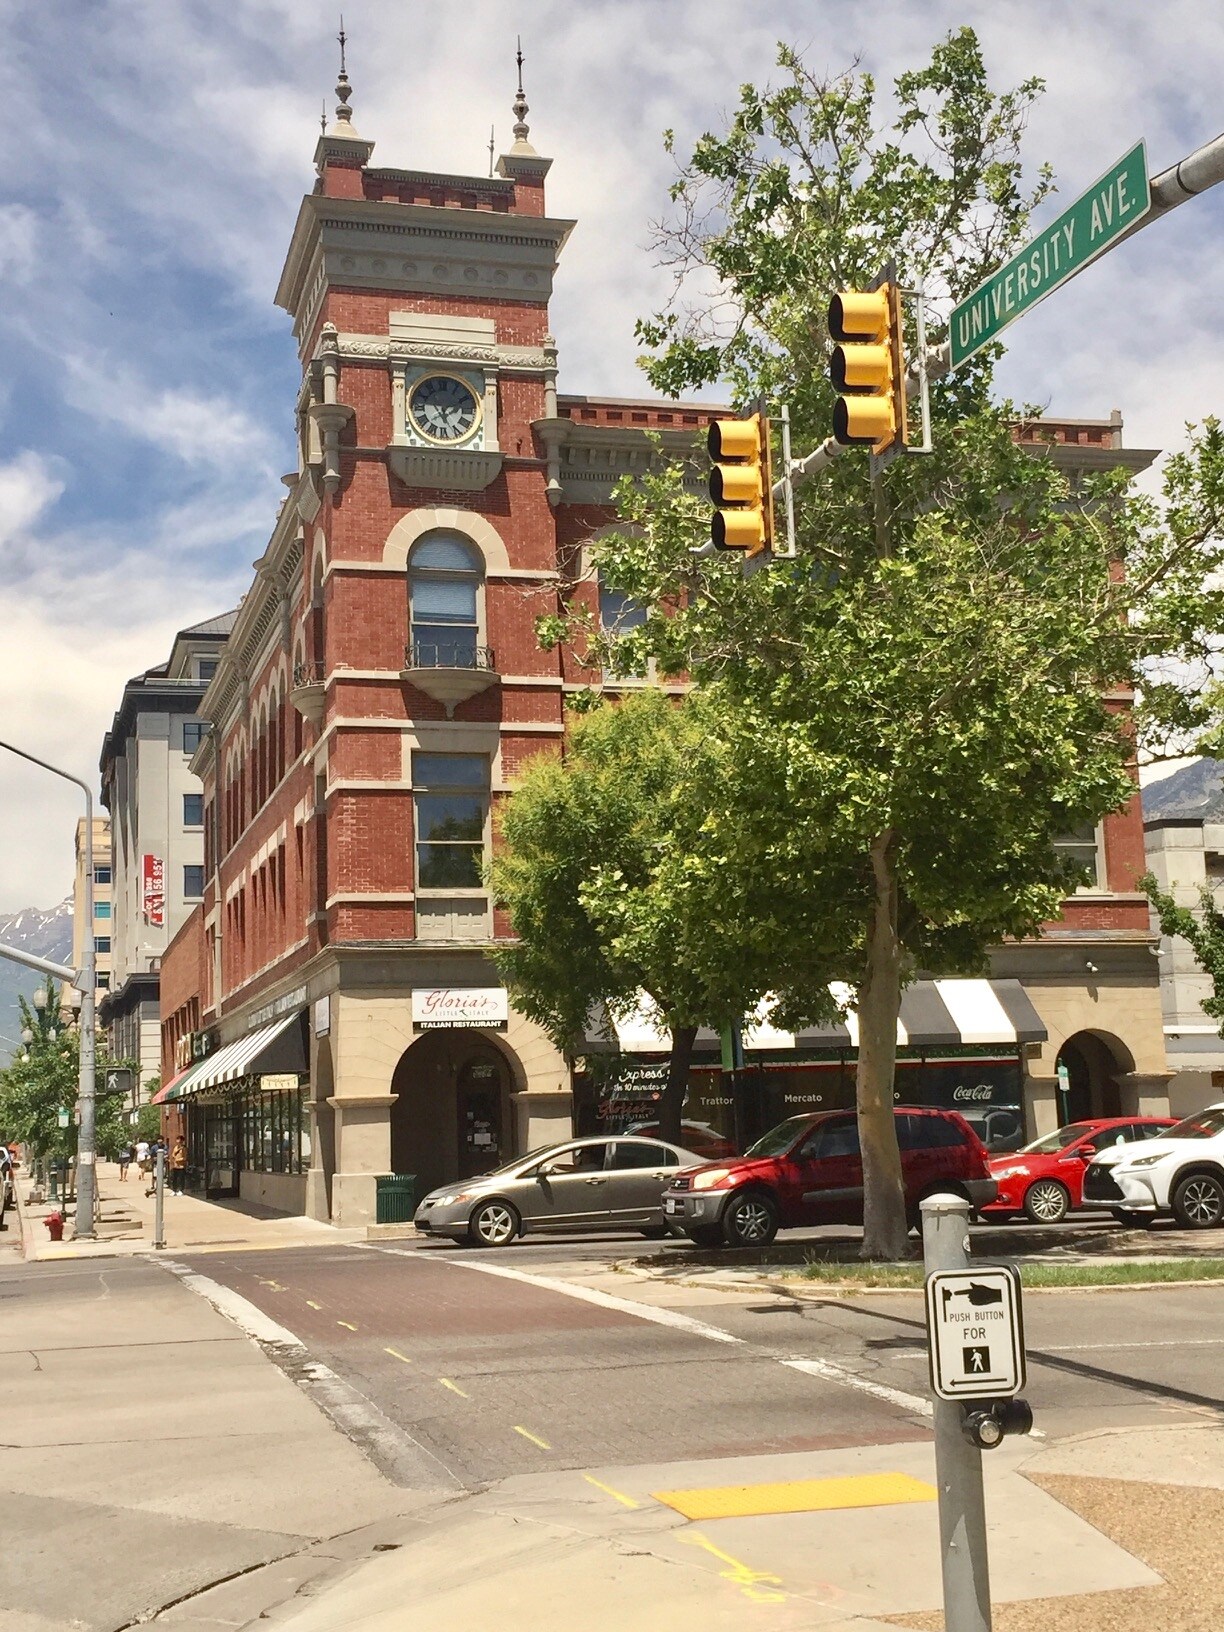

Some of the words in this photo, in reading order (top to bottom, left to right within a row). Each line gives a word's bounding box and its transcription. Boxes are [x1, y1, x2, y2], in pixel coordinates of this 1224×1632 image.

[958, 217, 1075, 348] UNIVERSITY
[1090, 170, 1136, 241] AVE.
[421, 989, 498, 1015] Gloria's
[421, 1021, 451, 1029] ITALIAN
[453, 1020, 502, 1028] RESTAURANT
[624, 1083, 633, 1092] 10
[633, 1083, 660, 1091] minutes
[700, 1096, 734, 1105] Trattor
[784, 1093, 823, 1103] Mercato
[949, 1312, 971, 1323] PUSH
[974, 1310, 1005, 1321] BUTTON
[963, 1327, 987, 1340] FOR
